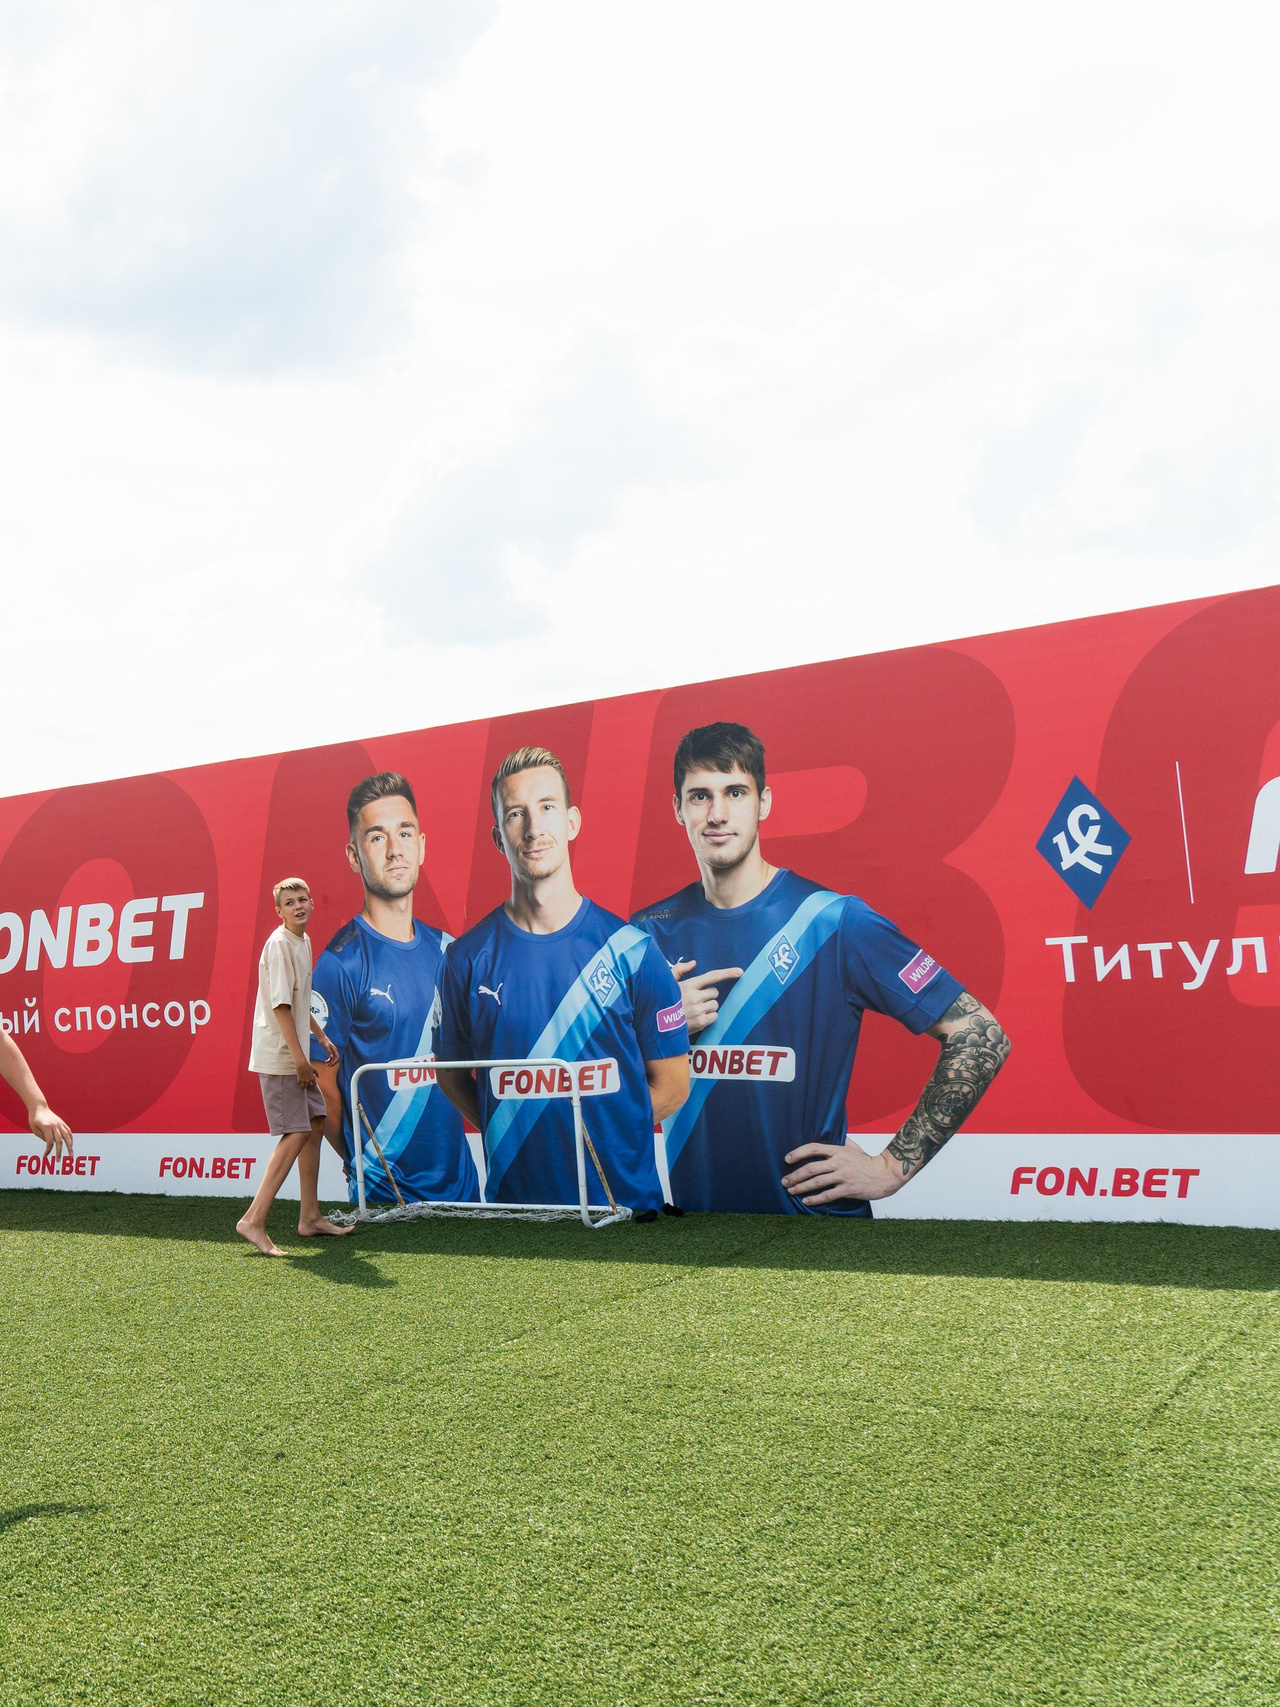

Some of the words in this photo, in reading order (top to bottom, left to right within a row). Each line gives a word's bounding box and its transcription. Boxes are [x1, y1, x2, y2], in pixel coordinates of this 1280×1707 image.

[1045, 935, 1280, 990] Титул
[54, 999, 211, 1034] спонсор
[688, 1050, 788, 1076] ONBET
[16, 1155, 100, 1176] FON.BET
[159, 1157, 256, 1179] FON.BET
[1010, 1167, 1200, 1198] FON.BET
